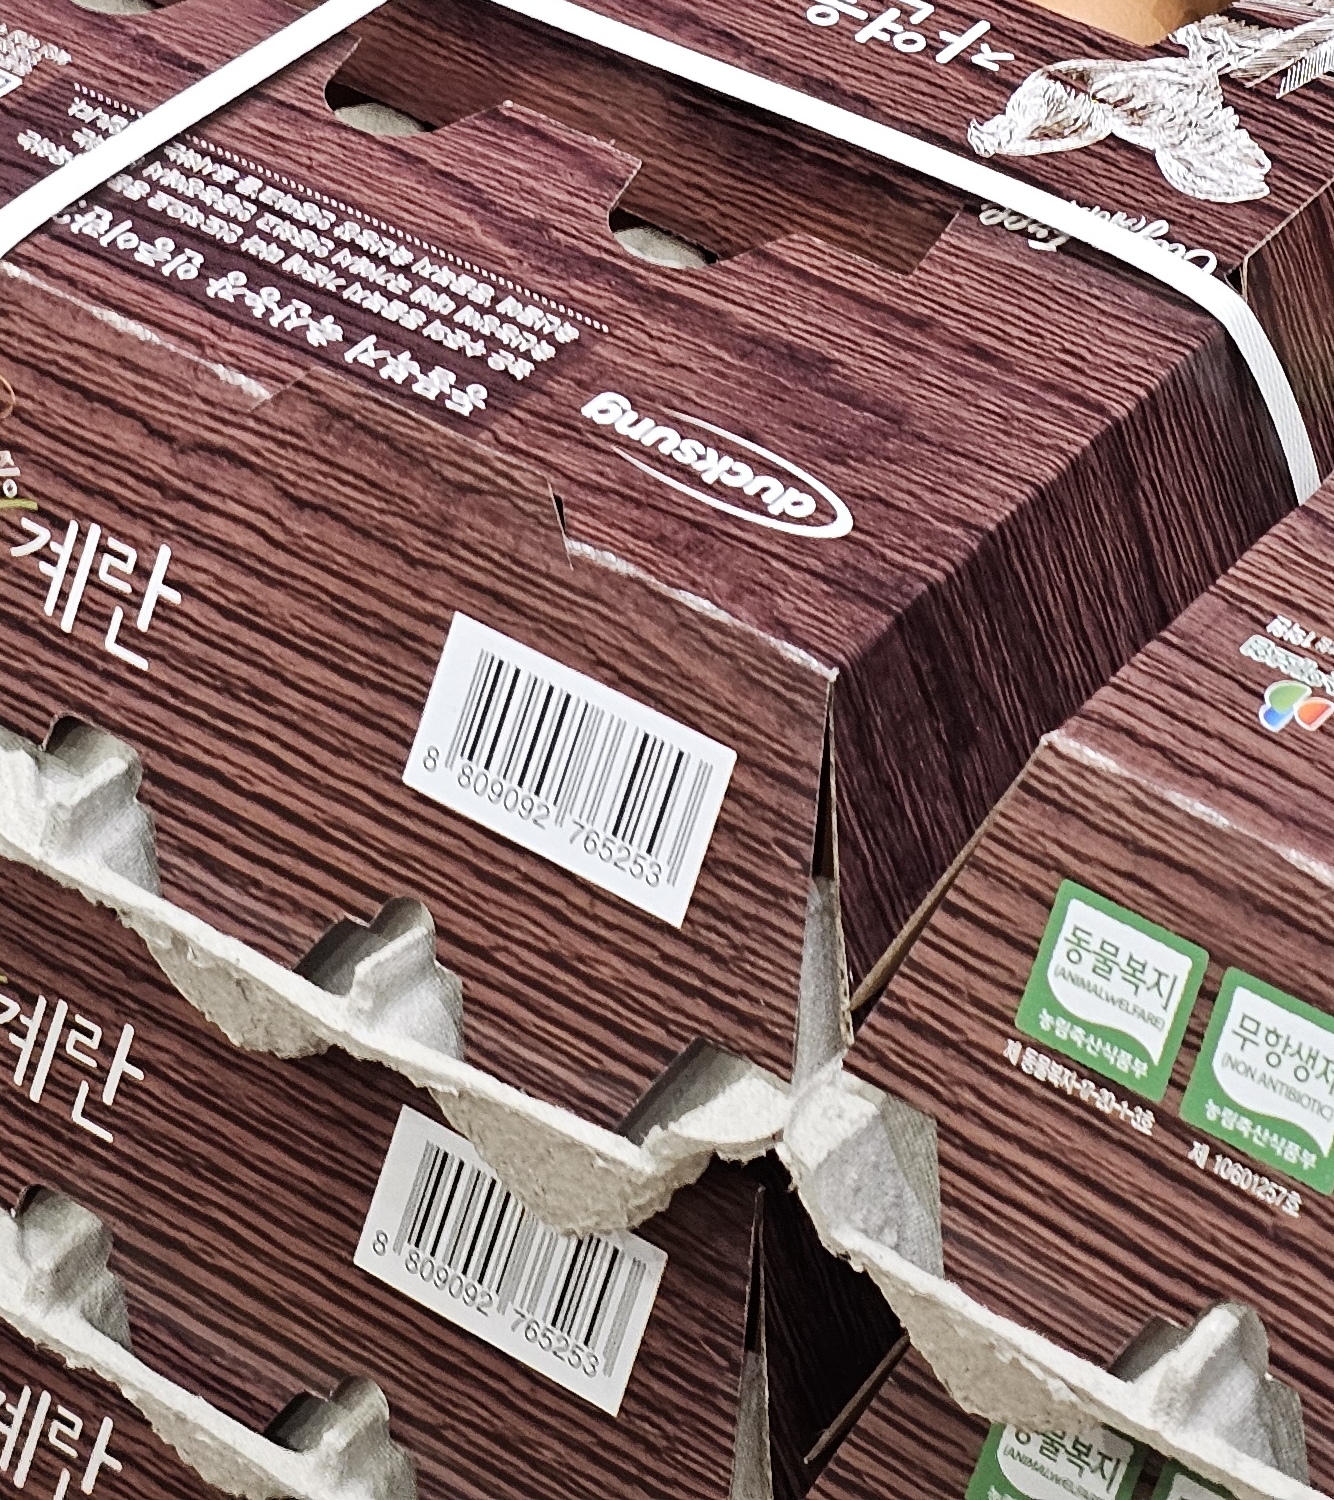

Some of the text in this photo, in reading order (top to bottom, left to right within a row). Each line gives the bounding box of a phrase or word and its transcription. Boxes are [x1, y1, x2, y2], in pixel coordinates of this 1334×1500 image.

[581, 389, 817, 523] ducksung
[11, 515, 182, 670] 계란
[421, 743, 661, 889] 8 809092 765253
[1065, 926, 1177, 1010] 동물복지
[1039, 1008, 1154, 1078] 농림축산식품부
[1216, 1048, 1333, 1122] (NON ANTIBIOTIC)
[1187, 1140, 1209, 1169] 제
[1205, 1099, 1323, 1169] 농림축산식품부
[372, 1230, 601, 1380] 8 809092 765253
